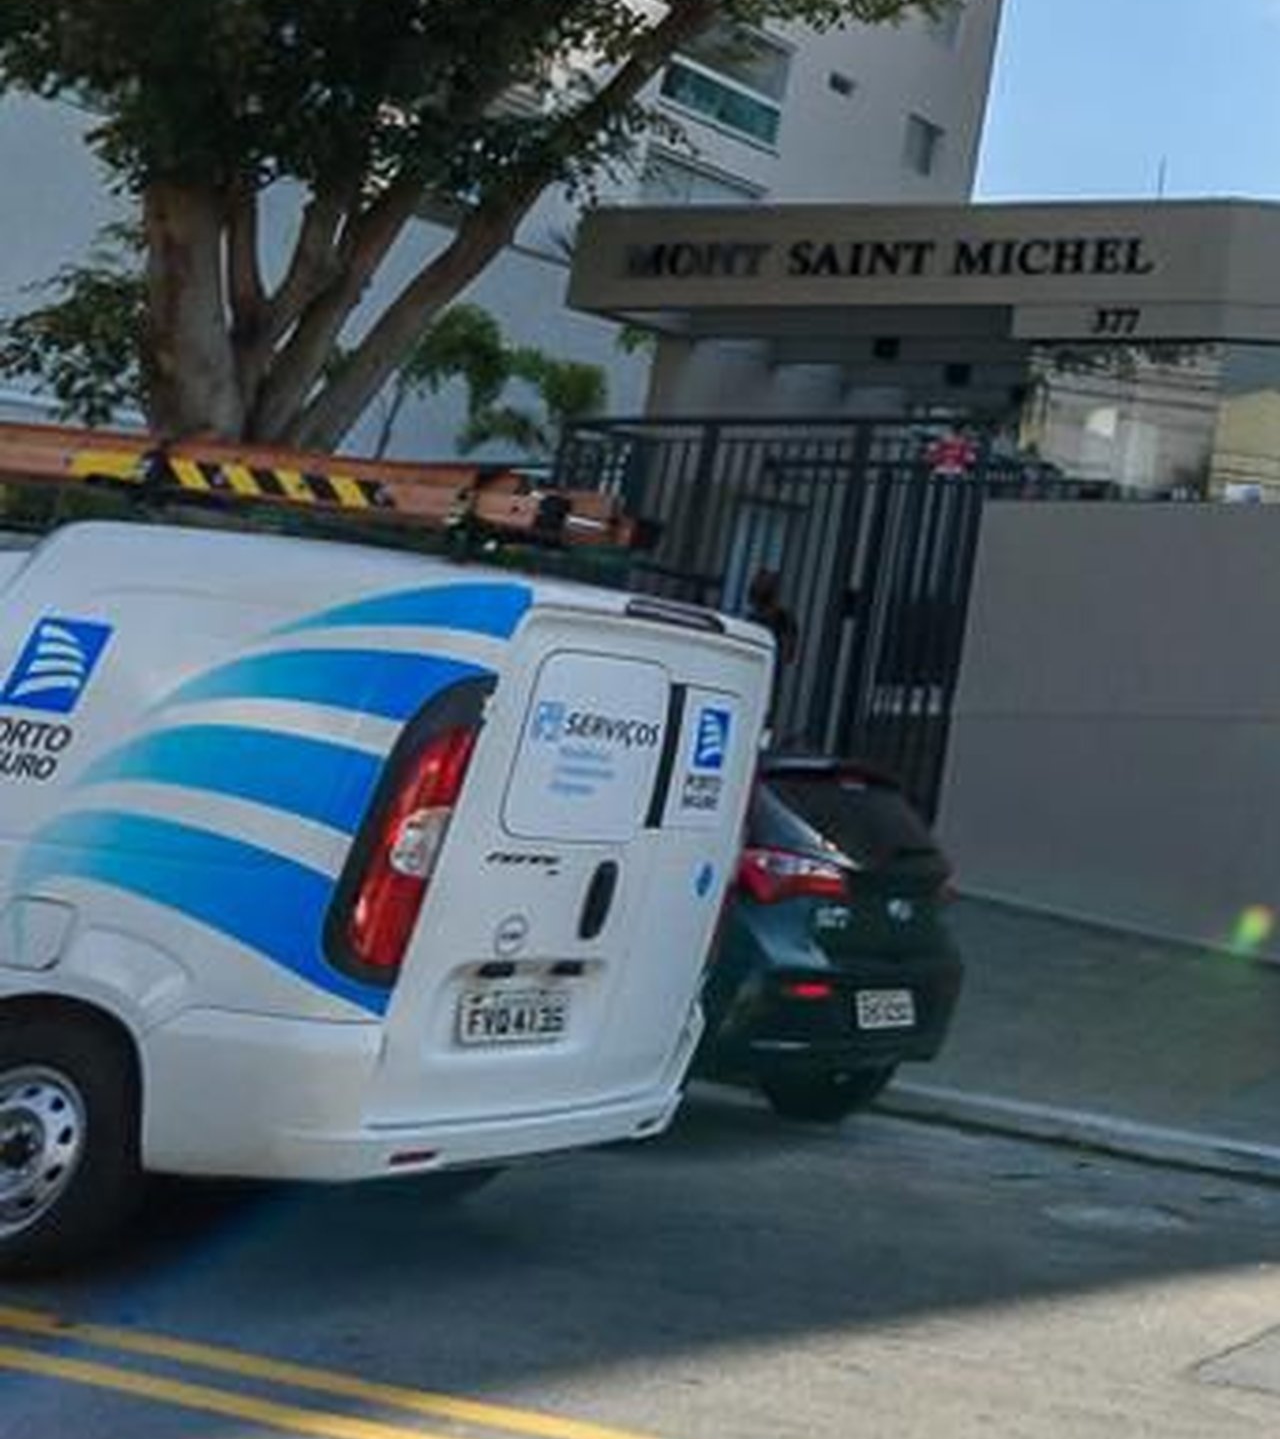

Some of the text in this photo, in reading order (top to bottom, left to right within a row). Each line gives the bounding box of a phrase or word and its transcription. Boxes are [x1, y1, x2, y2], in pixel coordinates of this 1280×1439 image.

[786, 239, 935, 277] SAINT
[953, 237, 1155, 276] MICHEL
[1090, 307, 1141, 334] 377
[563, 711, 662, 749] SERVIÇOS
